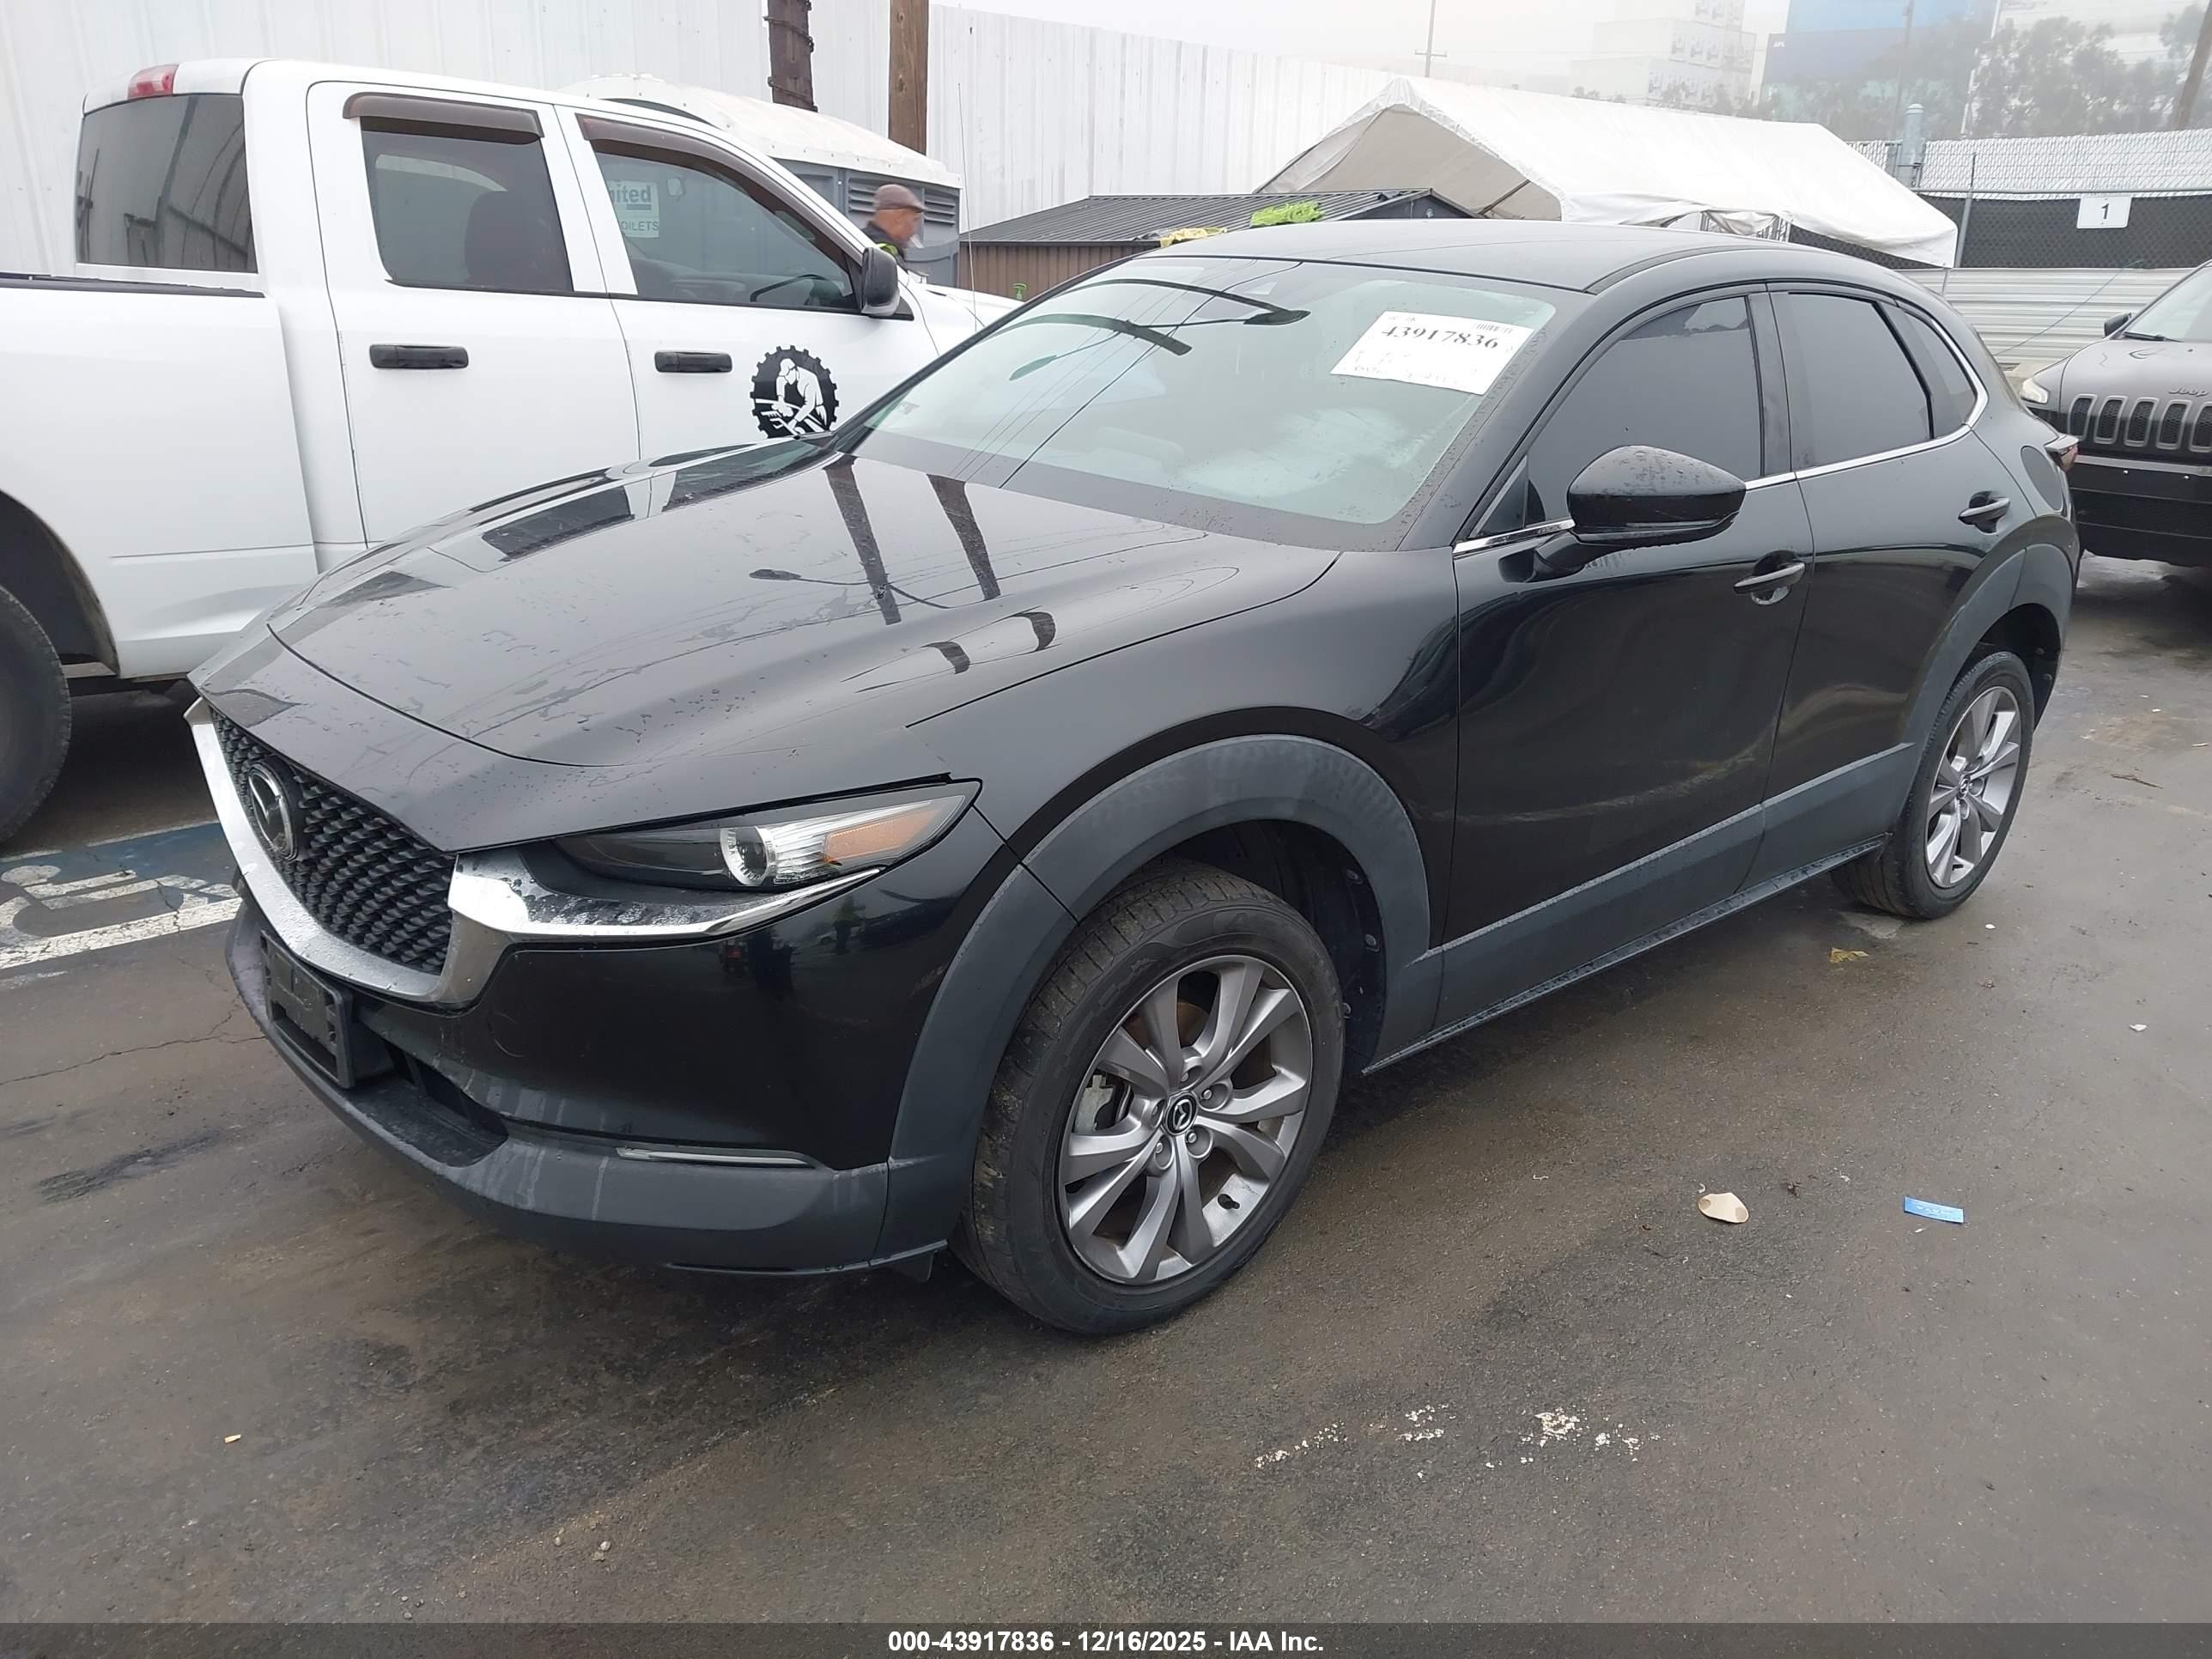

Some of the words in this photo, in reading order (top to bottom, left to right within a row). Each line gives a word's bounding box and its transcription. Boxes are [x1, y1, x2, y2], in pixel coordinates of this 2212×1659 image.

[609, 183, 652, 203] nited
[2101, 203, 2110, 220] 1
[621, 220, 660, 232] OILETS
[1382, 325, 1498, 349] 43917836
